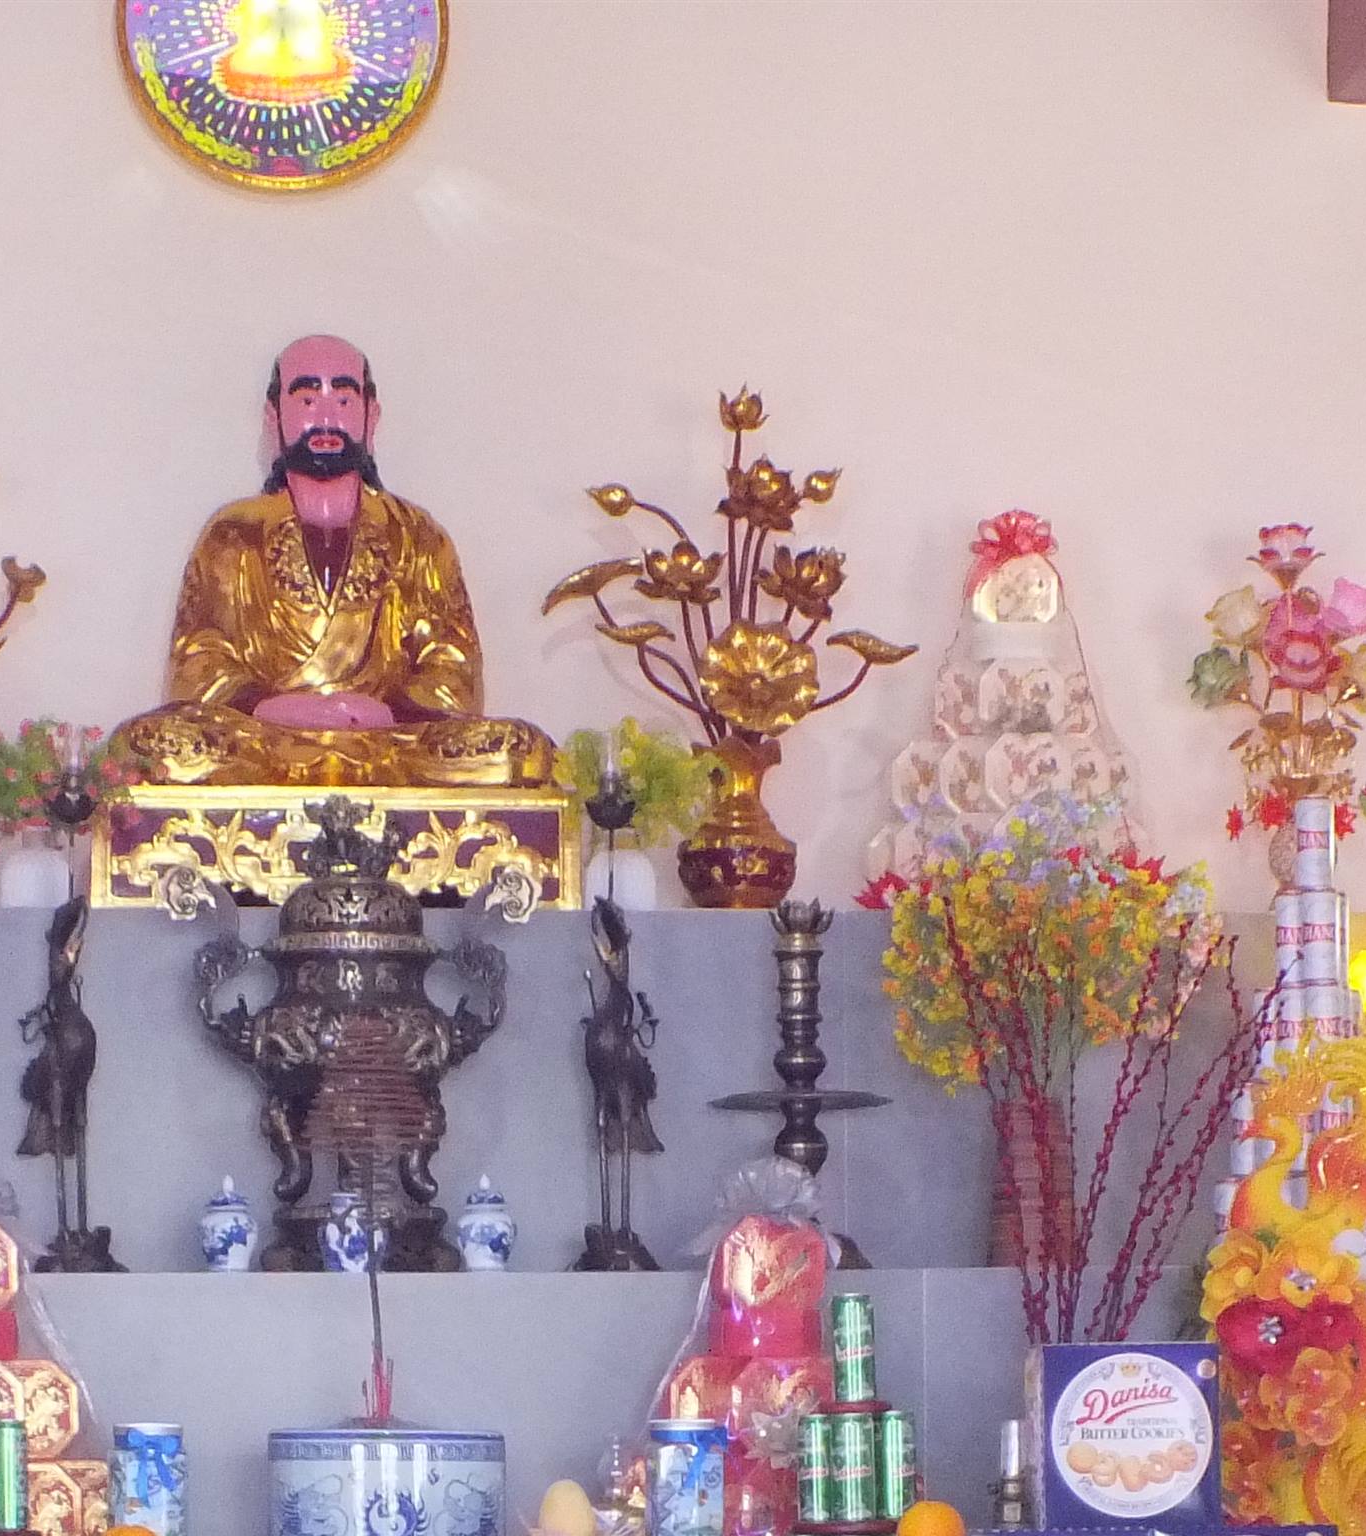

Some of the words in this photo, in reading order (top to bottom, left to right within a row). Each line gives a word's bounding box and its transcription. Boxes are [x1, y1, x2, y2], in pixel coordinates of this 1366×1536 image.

[1076, 1378, 1178, 1425] Danisa
[1080, 1426, 1130, 1440] BUTTER
[1131, 1426, 1185, 1440] COOKIES
